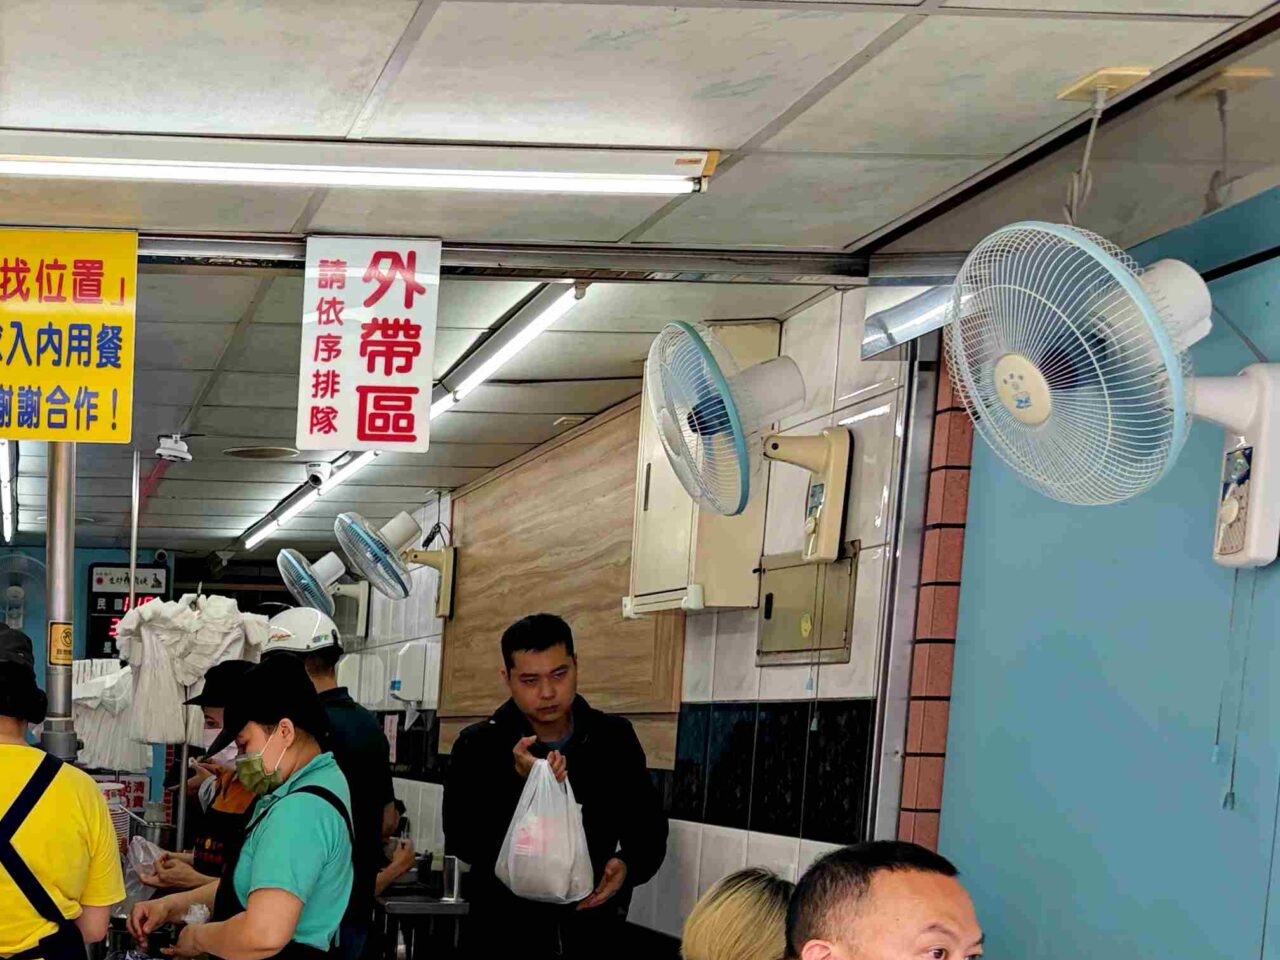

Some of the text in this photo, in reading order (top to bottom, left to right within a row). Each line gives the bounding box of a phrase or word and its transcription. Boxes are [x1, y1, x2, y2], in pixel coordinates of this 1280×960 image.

[309, 259, 347, 435] 請依序排隊
[356, 250, 426, 442] 外帶區
